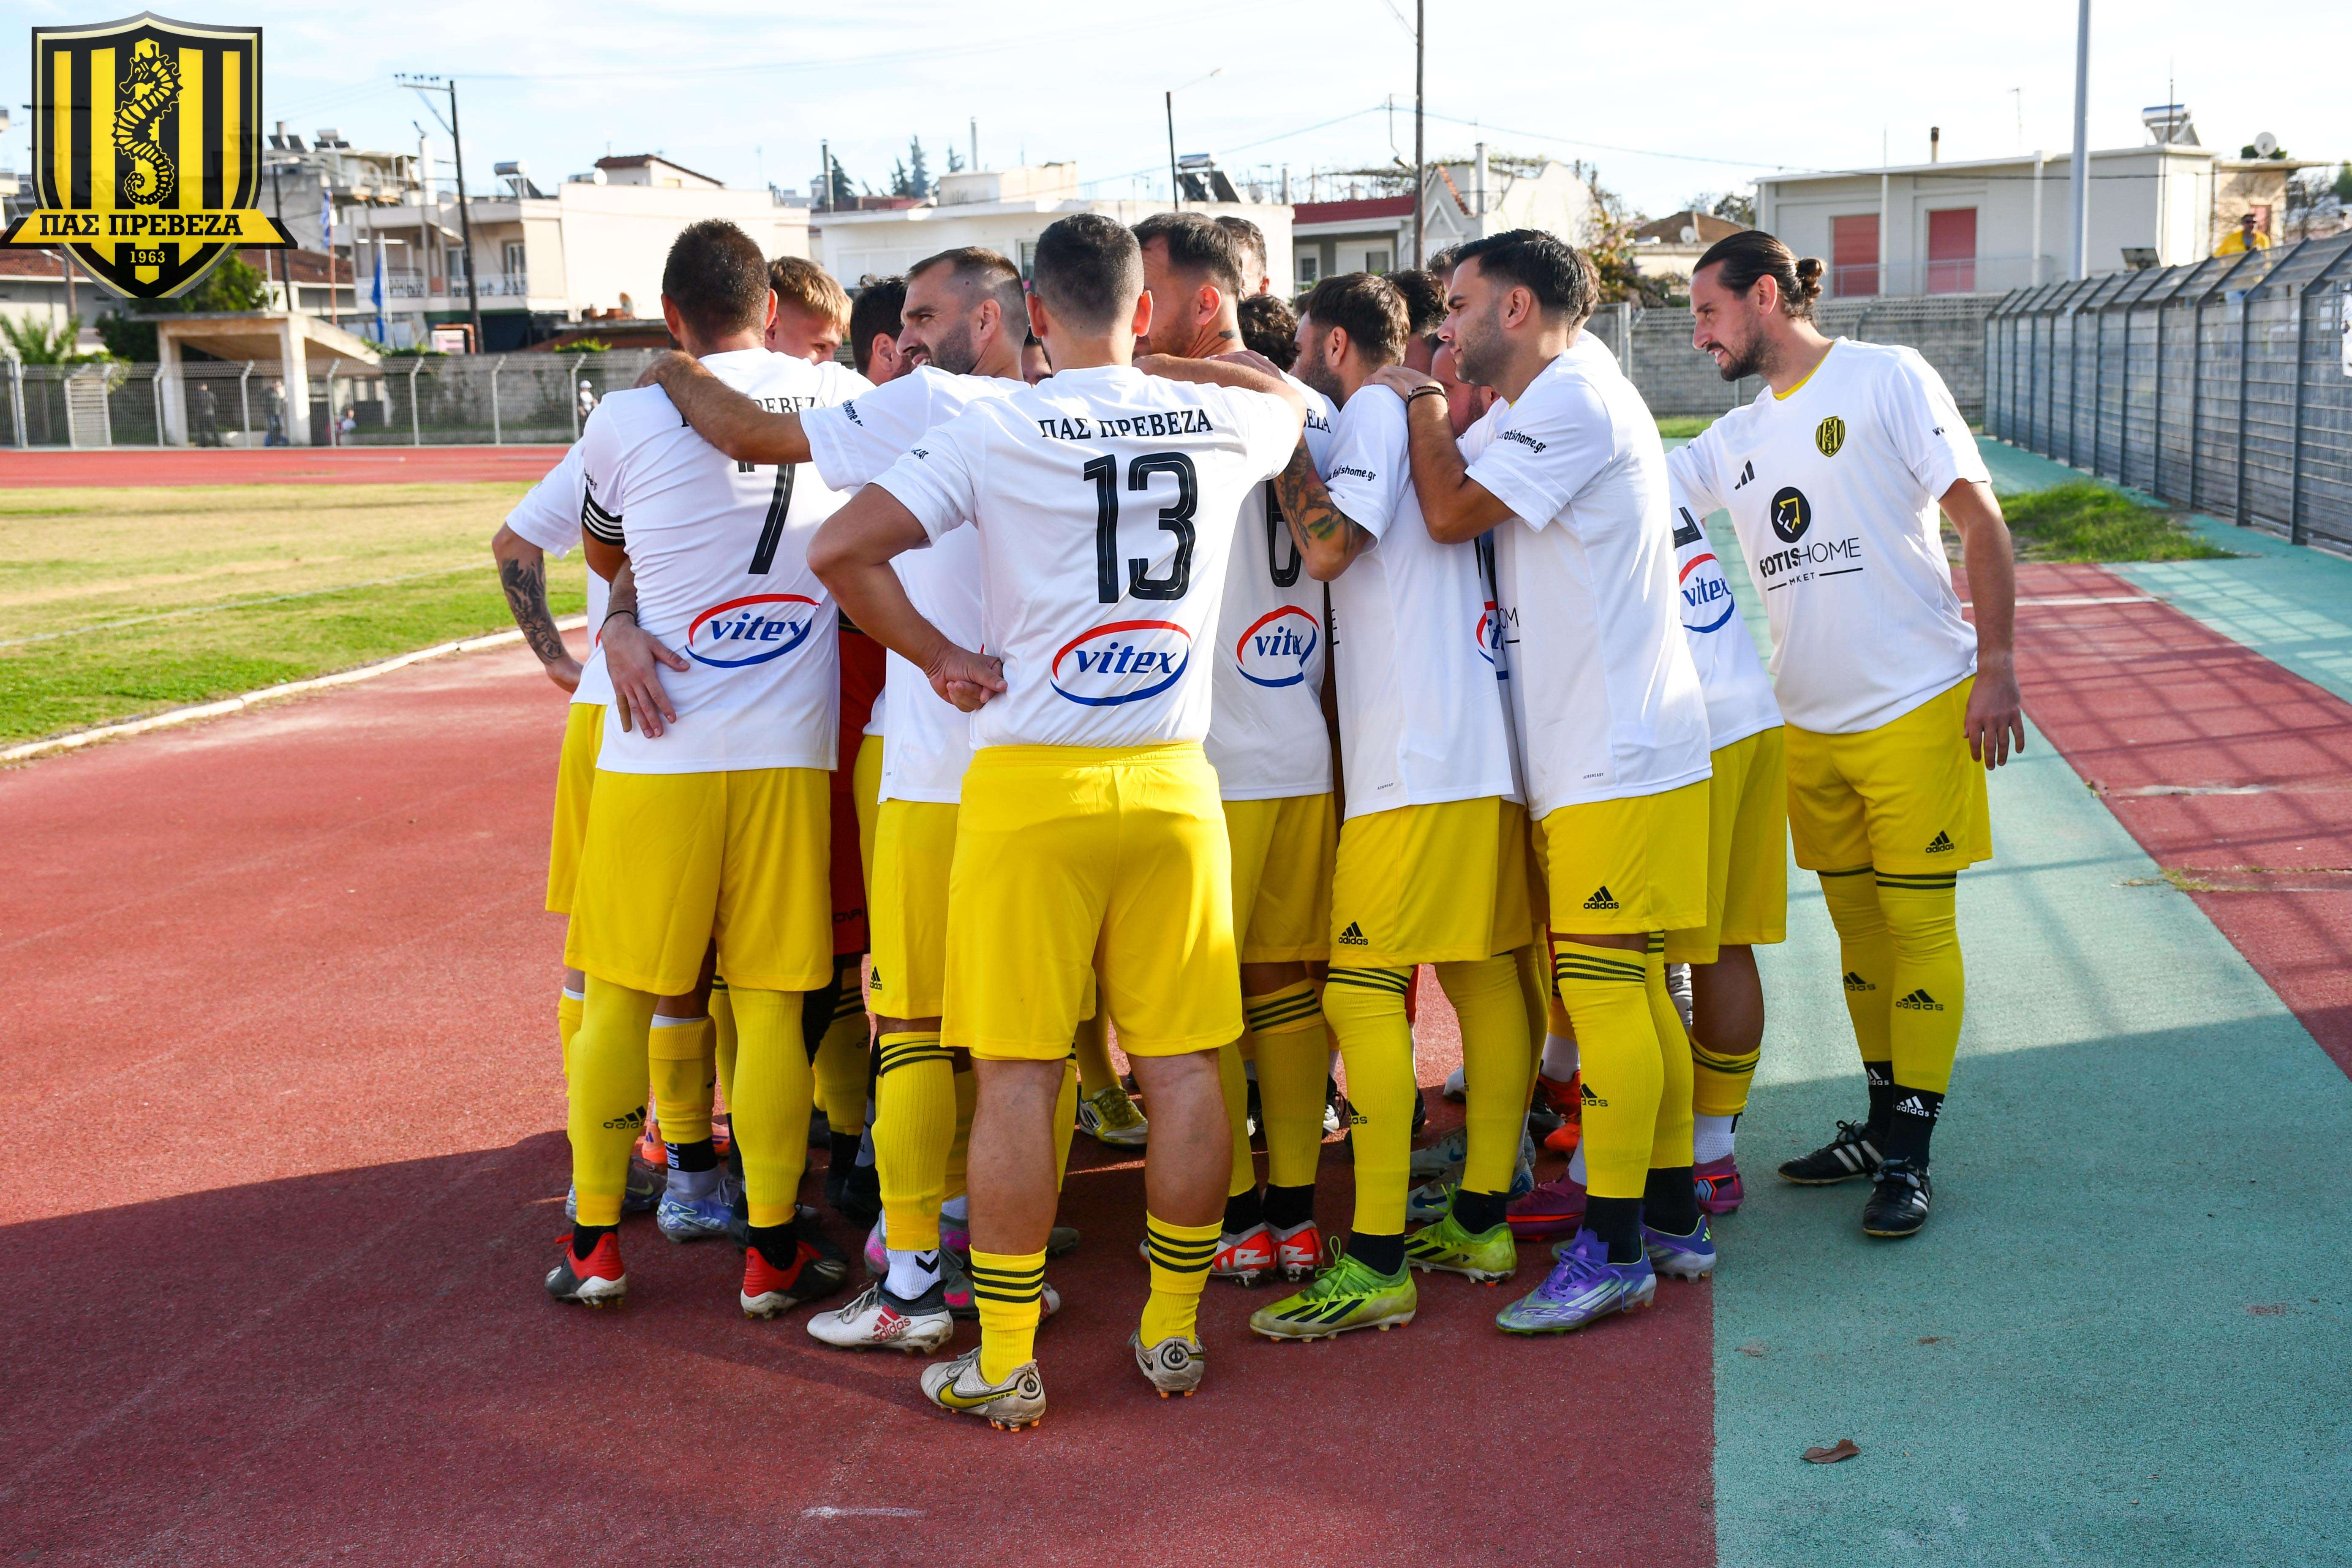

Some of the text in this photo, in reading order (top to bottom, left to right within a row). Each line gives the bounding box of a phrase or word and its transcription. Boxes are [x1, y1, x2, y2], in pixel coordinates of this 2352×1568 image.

[1038, 409, 1213, 440] ΠΑΣ ΠΡΕΒΕΖΑ
[1083, 452, 1198, 604] 13
[1682, 577, 1731, 607] vitex
[1075, 642, 1177, 673] vitex
[1926, 843, 1955, 853] adidas
[1583, 901, 1619, 909] adidas
[1338, 936, 1368, 945] adidas
[1896, 1000, 1944, 1011] adidas
[1896, 1104, 1929, 1117] adidas
[873, 1318, 911, 1342] adidas
